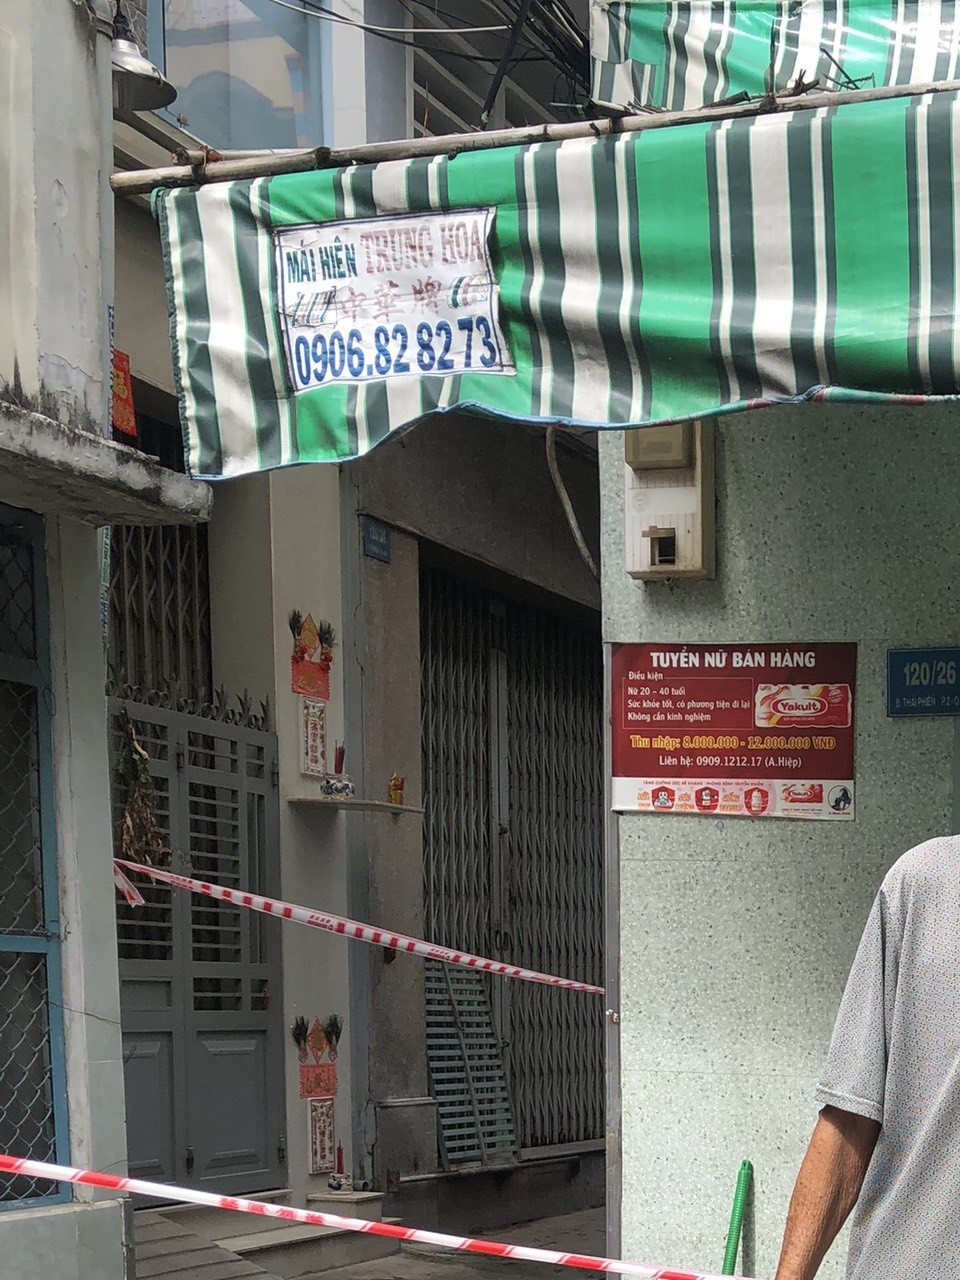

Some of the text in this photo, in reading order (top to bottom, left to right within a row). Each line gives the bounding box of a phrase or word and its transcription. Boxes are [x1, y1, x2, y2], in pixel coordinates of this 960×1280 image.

[319, 235, 358, 280] HIÊN
[360, 225, 434, 274] TRUNG
[439, 219, 485, 265] HOA
[650, 646, 816, 668] TUYỂN NỮ BÁN HÀNG
[628, 671, 663, 681] Điều kiện
[903, 660, 957, 686] 120/26
[627, 687, 638, 695] Nữ
[640, 687, 650, 695] 20
[659, 687, 669, 695] 40
[671, 686, 686, 696] tuổi
[627, 700, 640, 708] Sức
[687, 701, 714, 710] phương
[716, 700, 730, 709] tiện
[732, 700, 739, 708] đi
[741, 700, 750, 709] lại
[780, 702, 819, 712] Yakult
[627, 712, 711, 722] Không cần kinh nghiệm
[630, 735, 650, 749] Thu
[652, 735, 681, 751] nhập:
[682, 736, 739, 749] 8.000.000
[748, 736, 810, 749] 12.000.000
[813, 737, 835, 750] VNĐ
[659, 755, 802, 768] Liên hệ: 0909.1212.17 (A.Hiệp)
